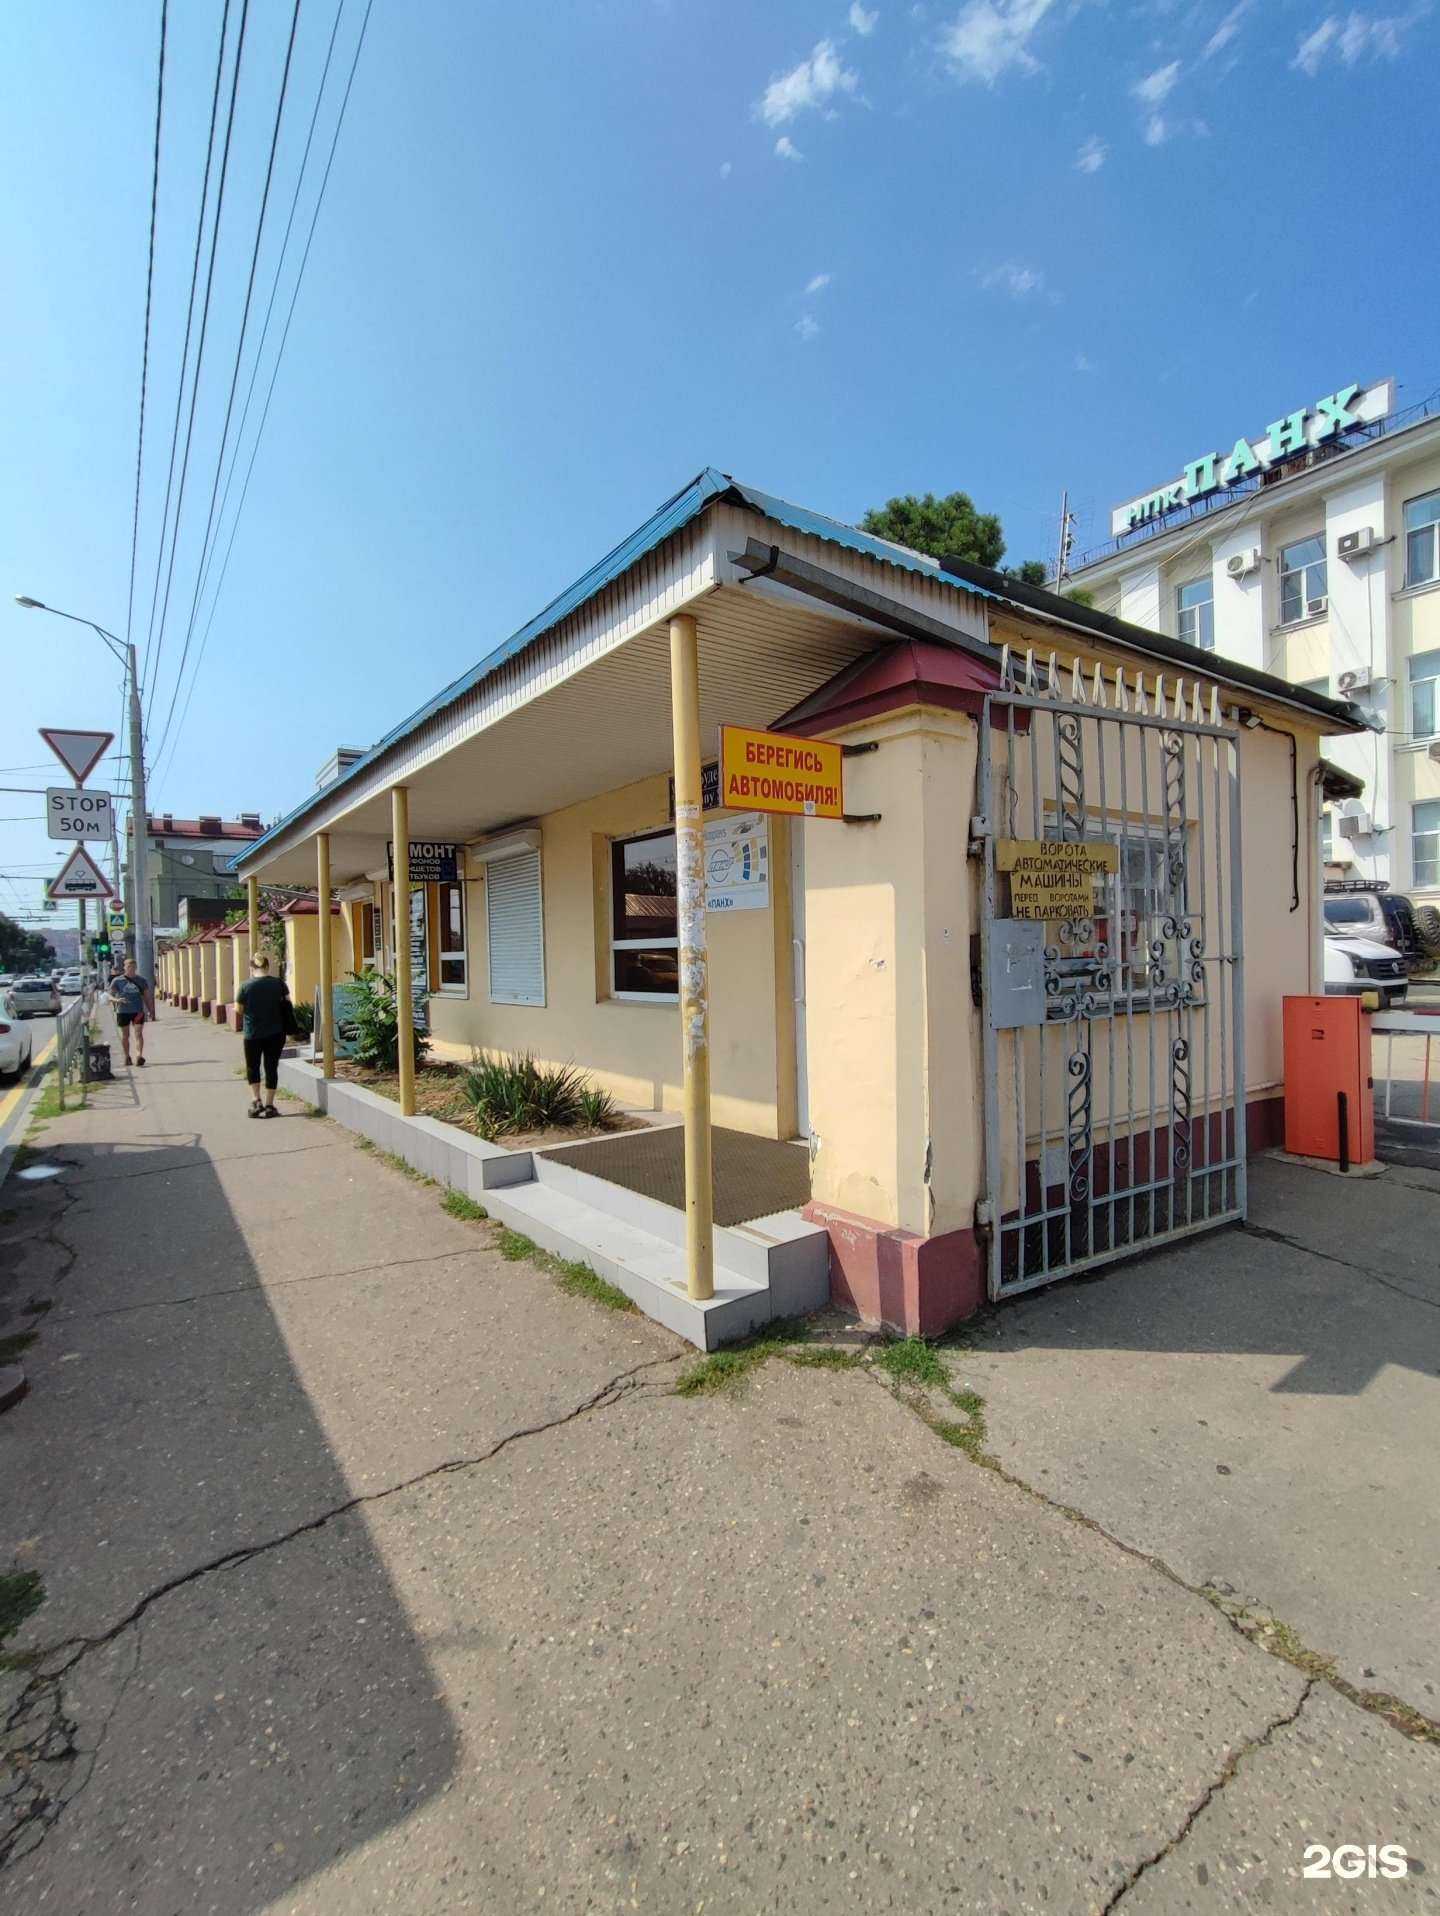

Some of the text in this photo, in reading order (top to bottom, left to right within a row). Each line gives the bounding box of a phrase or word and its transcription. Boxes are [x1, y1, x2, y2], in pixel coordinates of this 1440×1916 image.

[1184, 383, 1360, 500] ПАНХ
[745, 741, 824, 773] БЕРЕГИСЬ
[728, 773, 838, 806] АВТОМОБИЛЯ!
[51, 795, 108, 812] STOP
[1040, 843, 1088, 857] ВОРОТА
[1014, 857, 1108, 873] АВТОМАТИЧЕСКИЕ
[1020, 873, 1083, 889] МАШИНЫ
[1049, 893, 1090, 903] ВОРОТАМИ
[1016, 904, 1090, 918] НЕ ПАРКОВАТЬ
